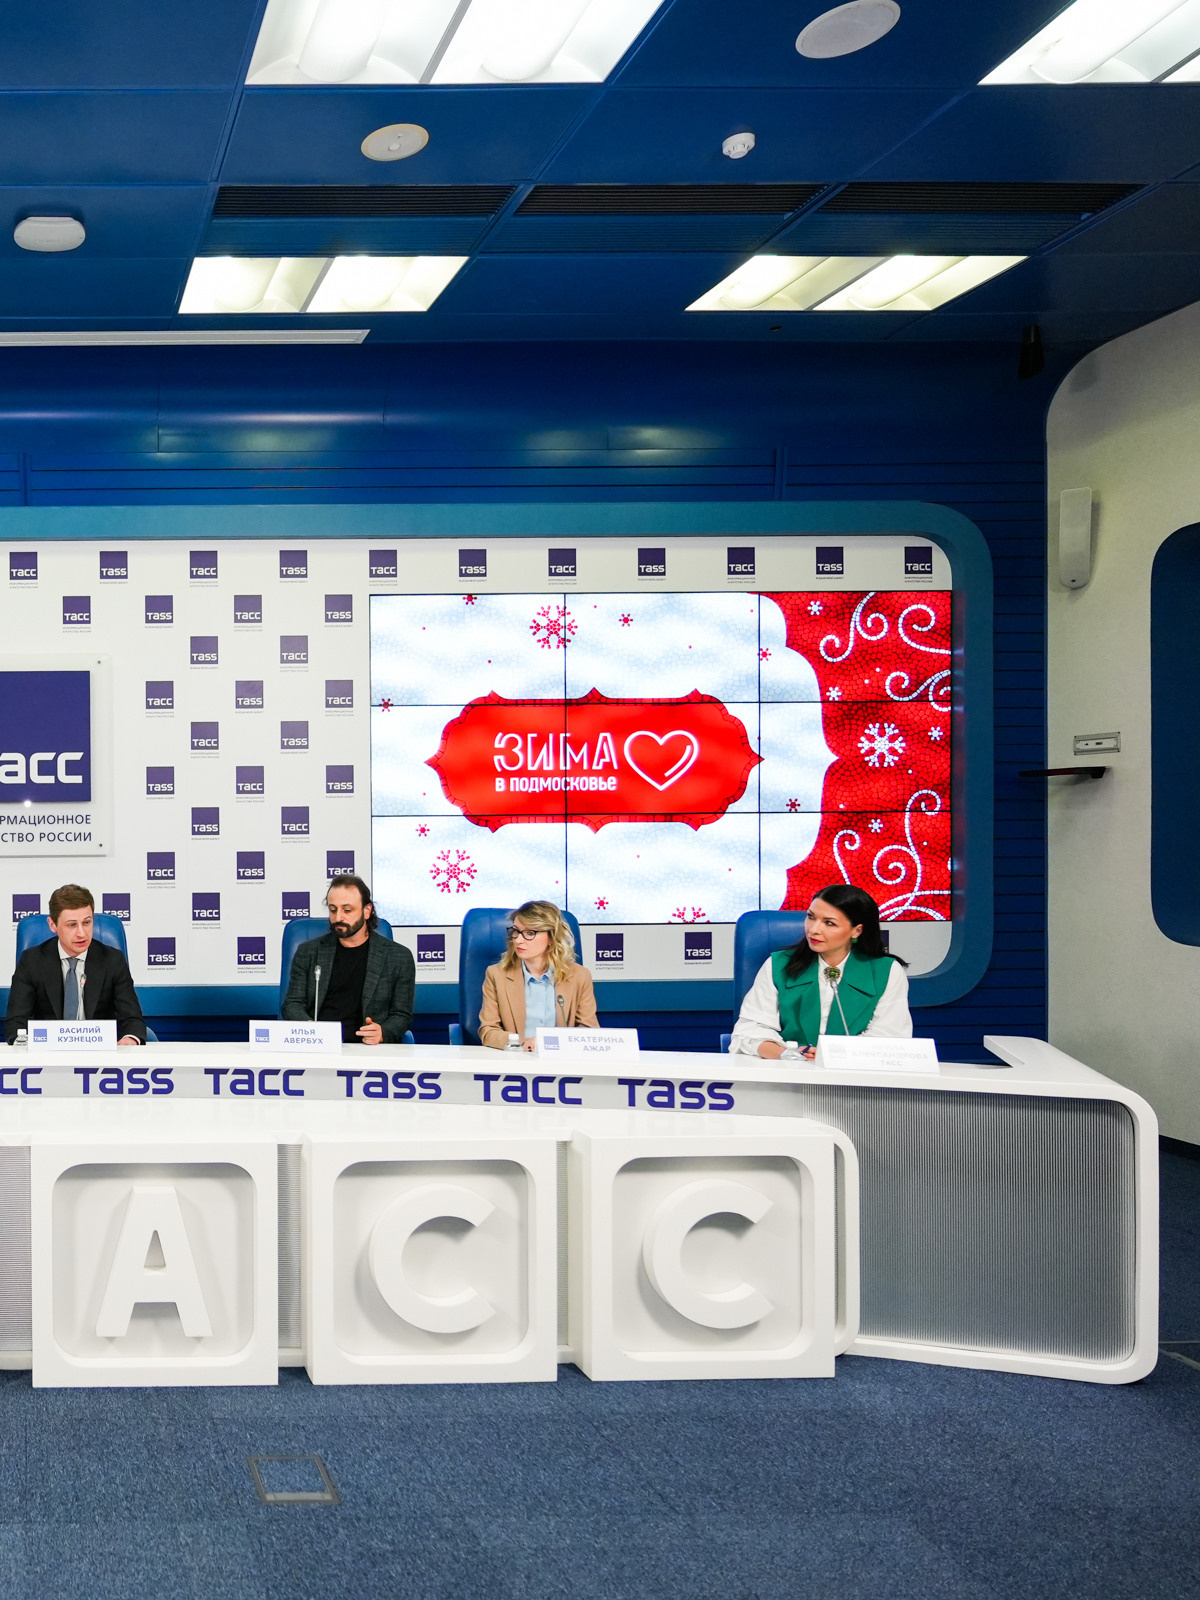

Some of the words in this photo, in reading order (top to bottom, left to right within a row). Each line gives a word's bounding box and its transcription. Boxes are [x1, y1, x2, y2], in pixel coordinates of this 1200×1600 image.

[39, 831, 92, 842] РОССИИ
[59, 1026, 101, 1034] ВАСИЛИЙ
[568, 1035, 625, 1043] ЕКАТЕРИНА
